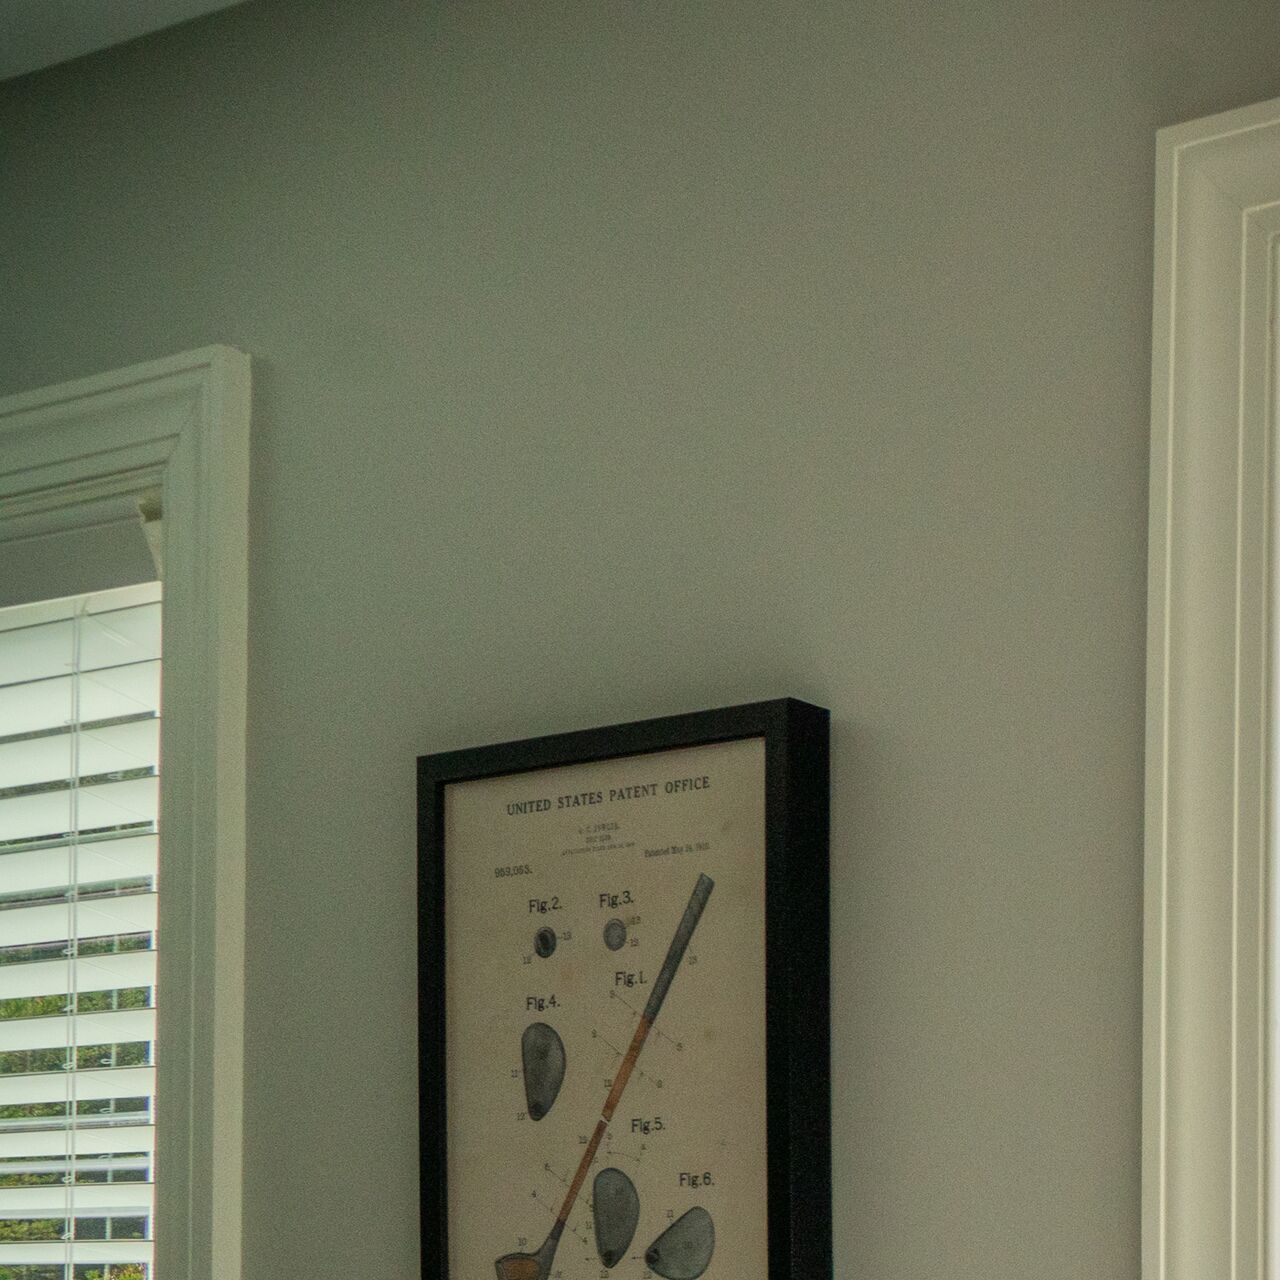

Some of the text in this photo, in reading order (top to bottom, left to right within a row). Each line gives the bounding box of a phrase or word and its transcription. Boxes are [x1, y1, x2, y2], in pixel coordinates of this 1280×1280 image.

[506, 776, 710, 816] UNITED STATES PATENT OFFICE
